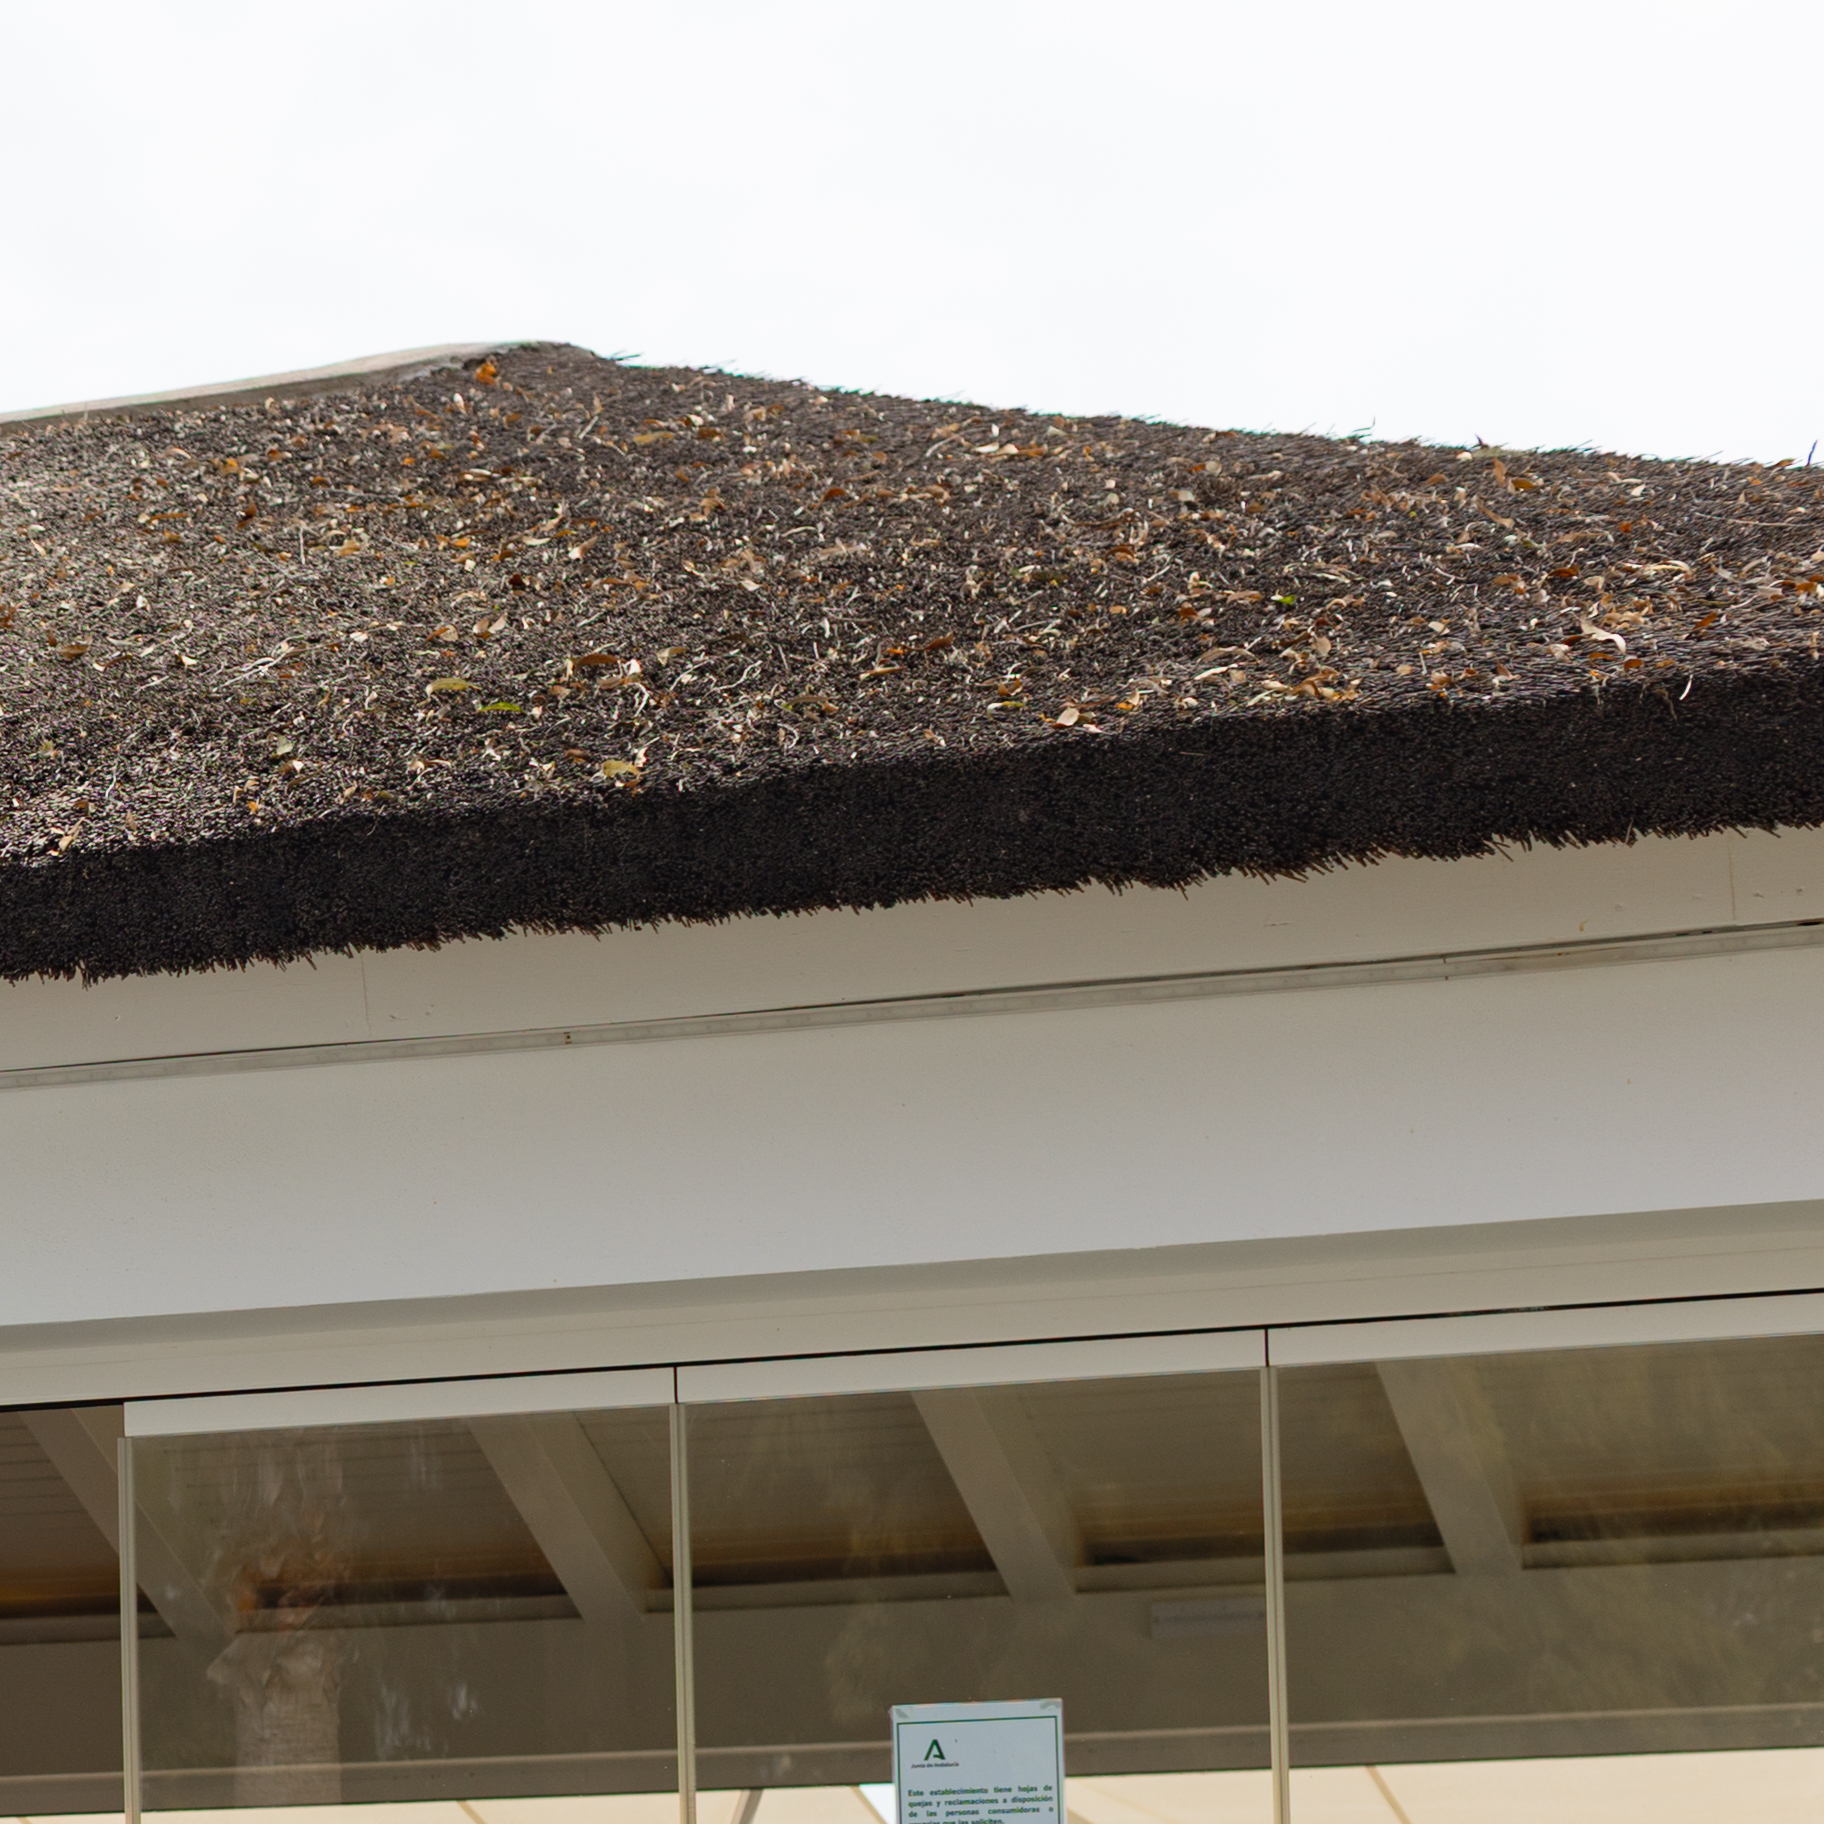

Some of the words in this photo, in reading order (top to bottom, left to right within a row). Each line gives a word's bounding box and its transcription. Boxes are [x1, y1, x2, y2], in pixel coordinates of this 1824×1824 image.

[929, 1787, 988, 1796] establecimiento
[1018, 1785, 1038, 1793] hojas
[908, 1800, 933, 1808] quejas
[944, 1798, 999, 1806] reclamaciones
[1011, 1795, 1053, 1803] disposición
[945, 1809, 979, 1817] personas
[988, 1806, 1040, 1815] consumidoras
